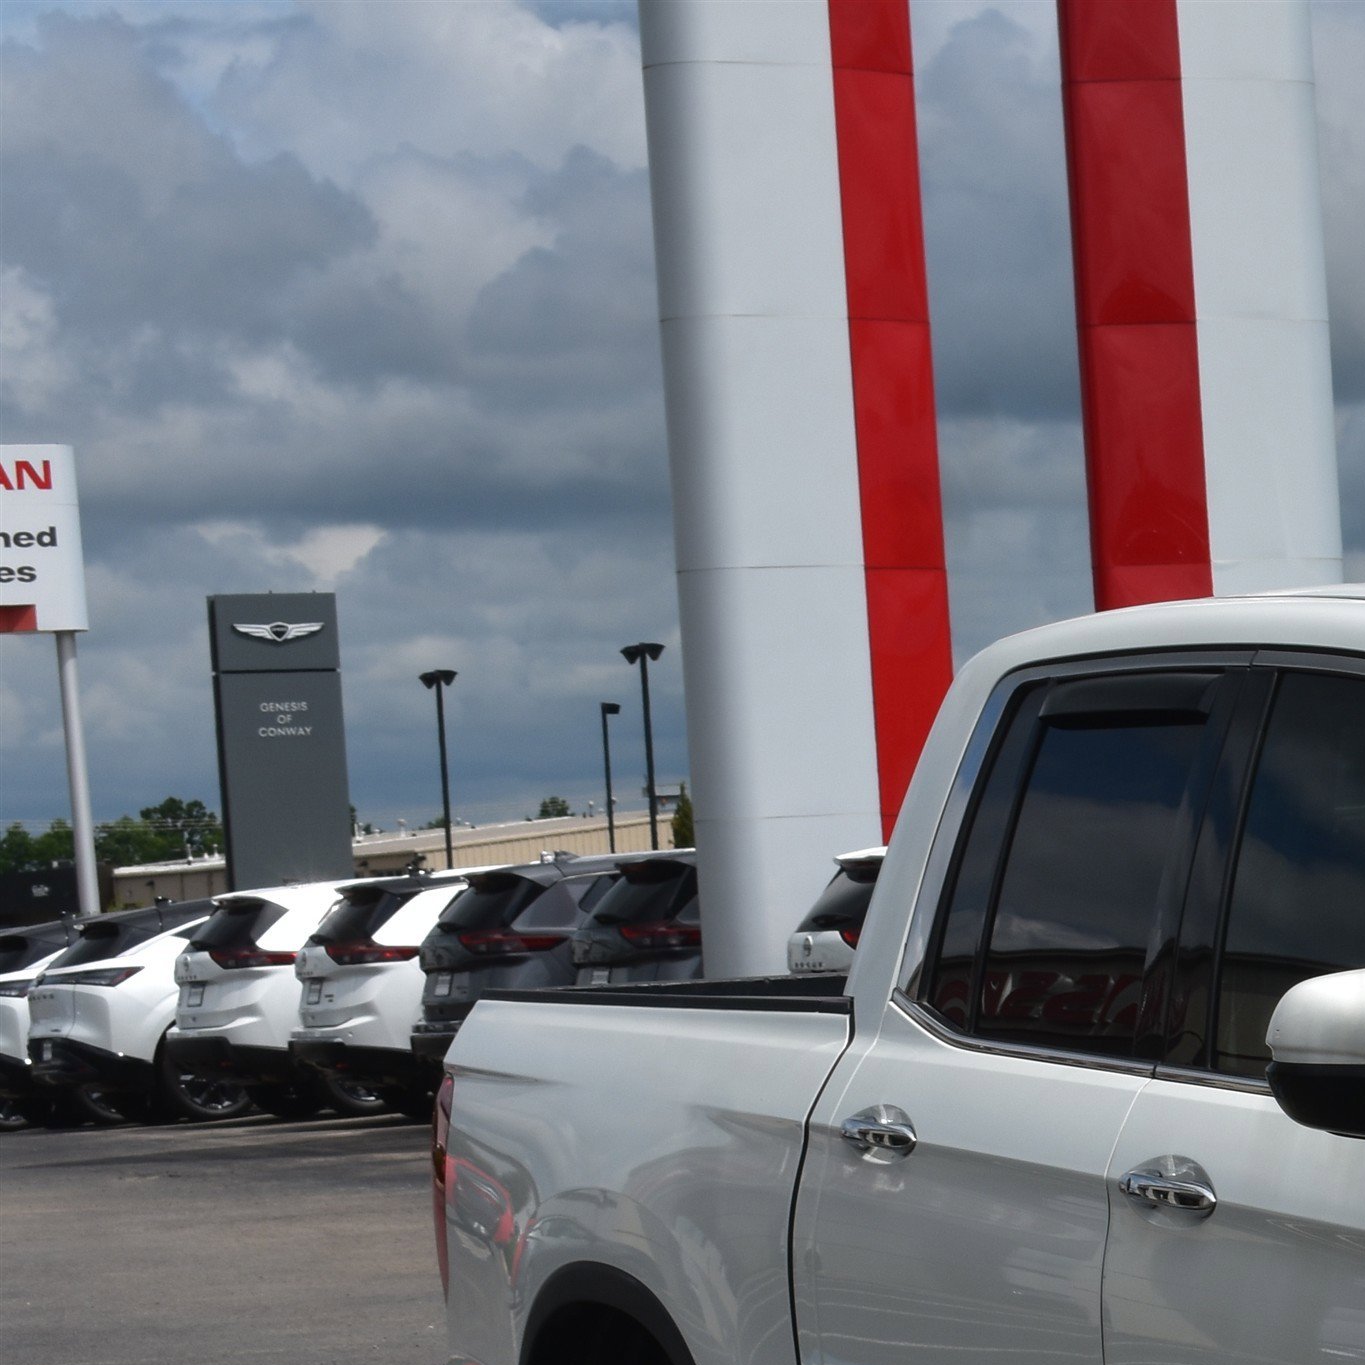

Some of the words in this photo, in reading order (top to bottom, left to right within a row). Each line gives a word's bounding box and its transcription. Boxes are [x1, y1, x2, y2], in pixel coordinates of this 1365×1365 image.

[260, 702, 308, 712] GENESIS
[277, 715, 292, 724] OF
[258, 727, 312, 737] CONWAY
